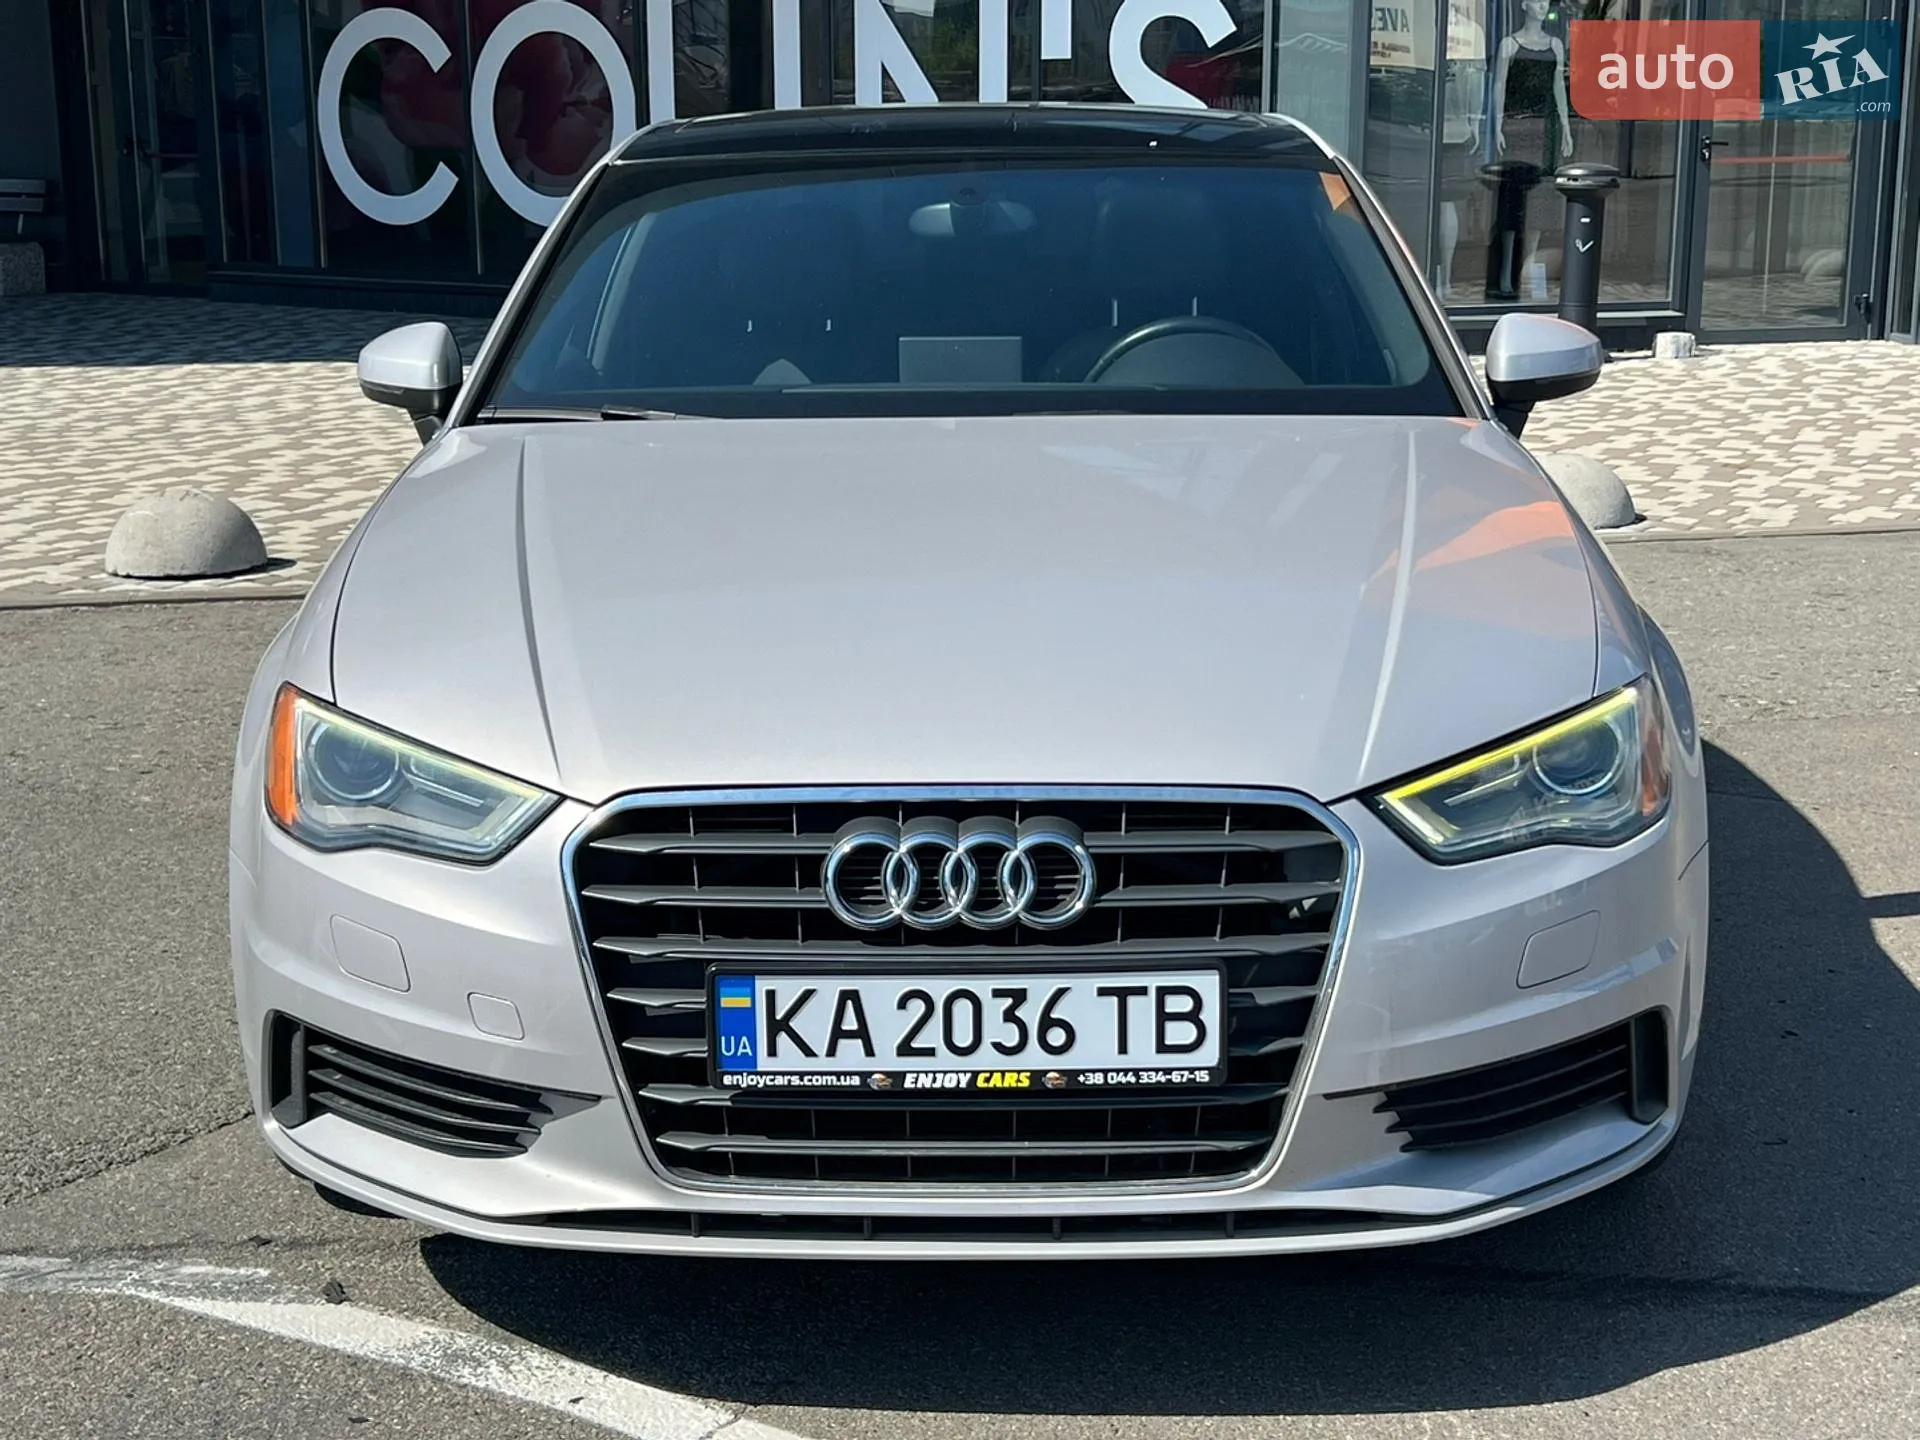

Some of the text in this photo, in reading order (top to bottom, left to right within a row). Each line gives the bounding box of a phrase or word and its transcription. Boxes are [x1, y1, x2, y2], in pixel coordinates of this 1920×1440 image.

[764, 984, 1207, 1058] KA 2036 TB
[721, 1035, 753, 1057] UA
[722, 1072, 861, 1088] enjoycars.com.ua
[903, 1071, 1031, 1089] ENJOY CARS
[1076, 1069, 1210, 1085] +38 044 334-67-15
